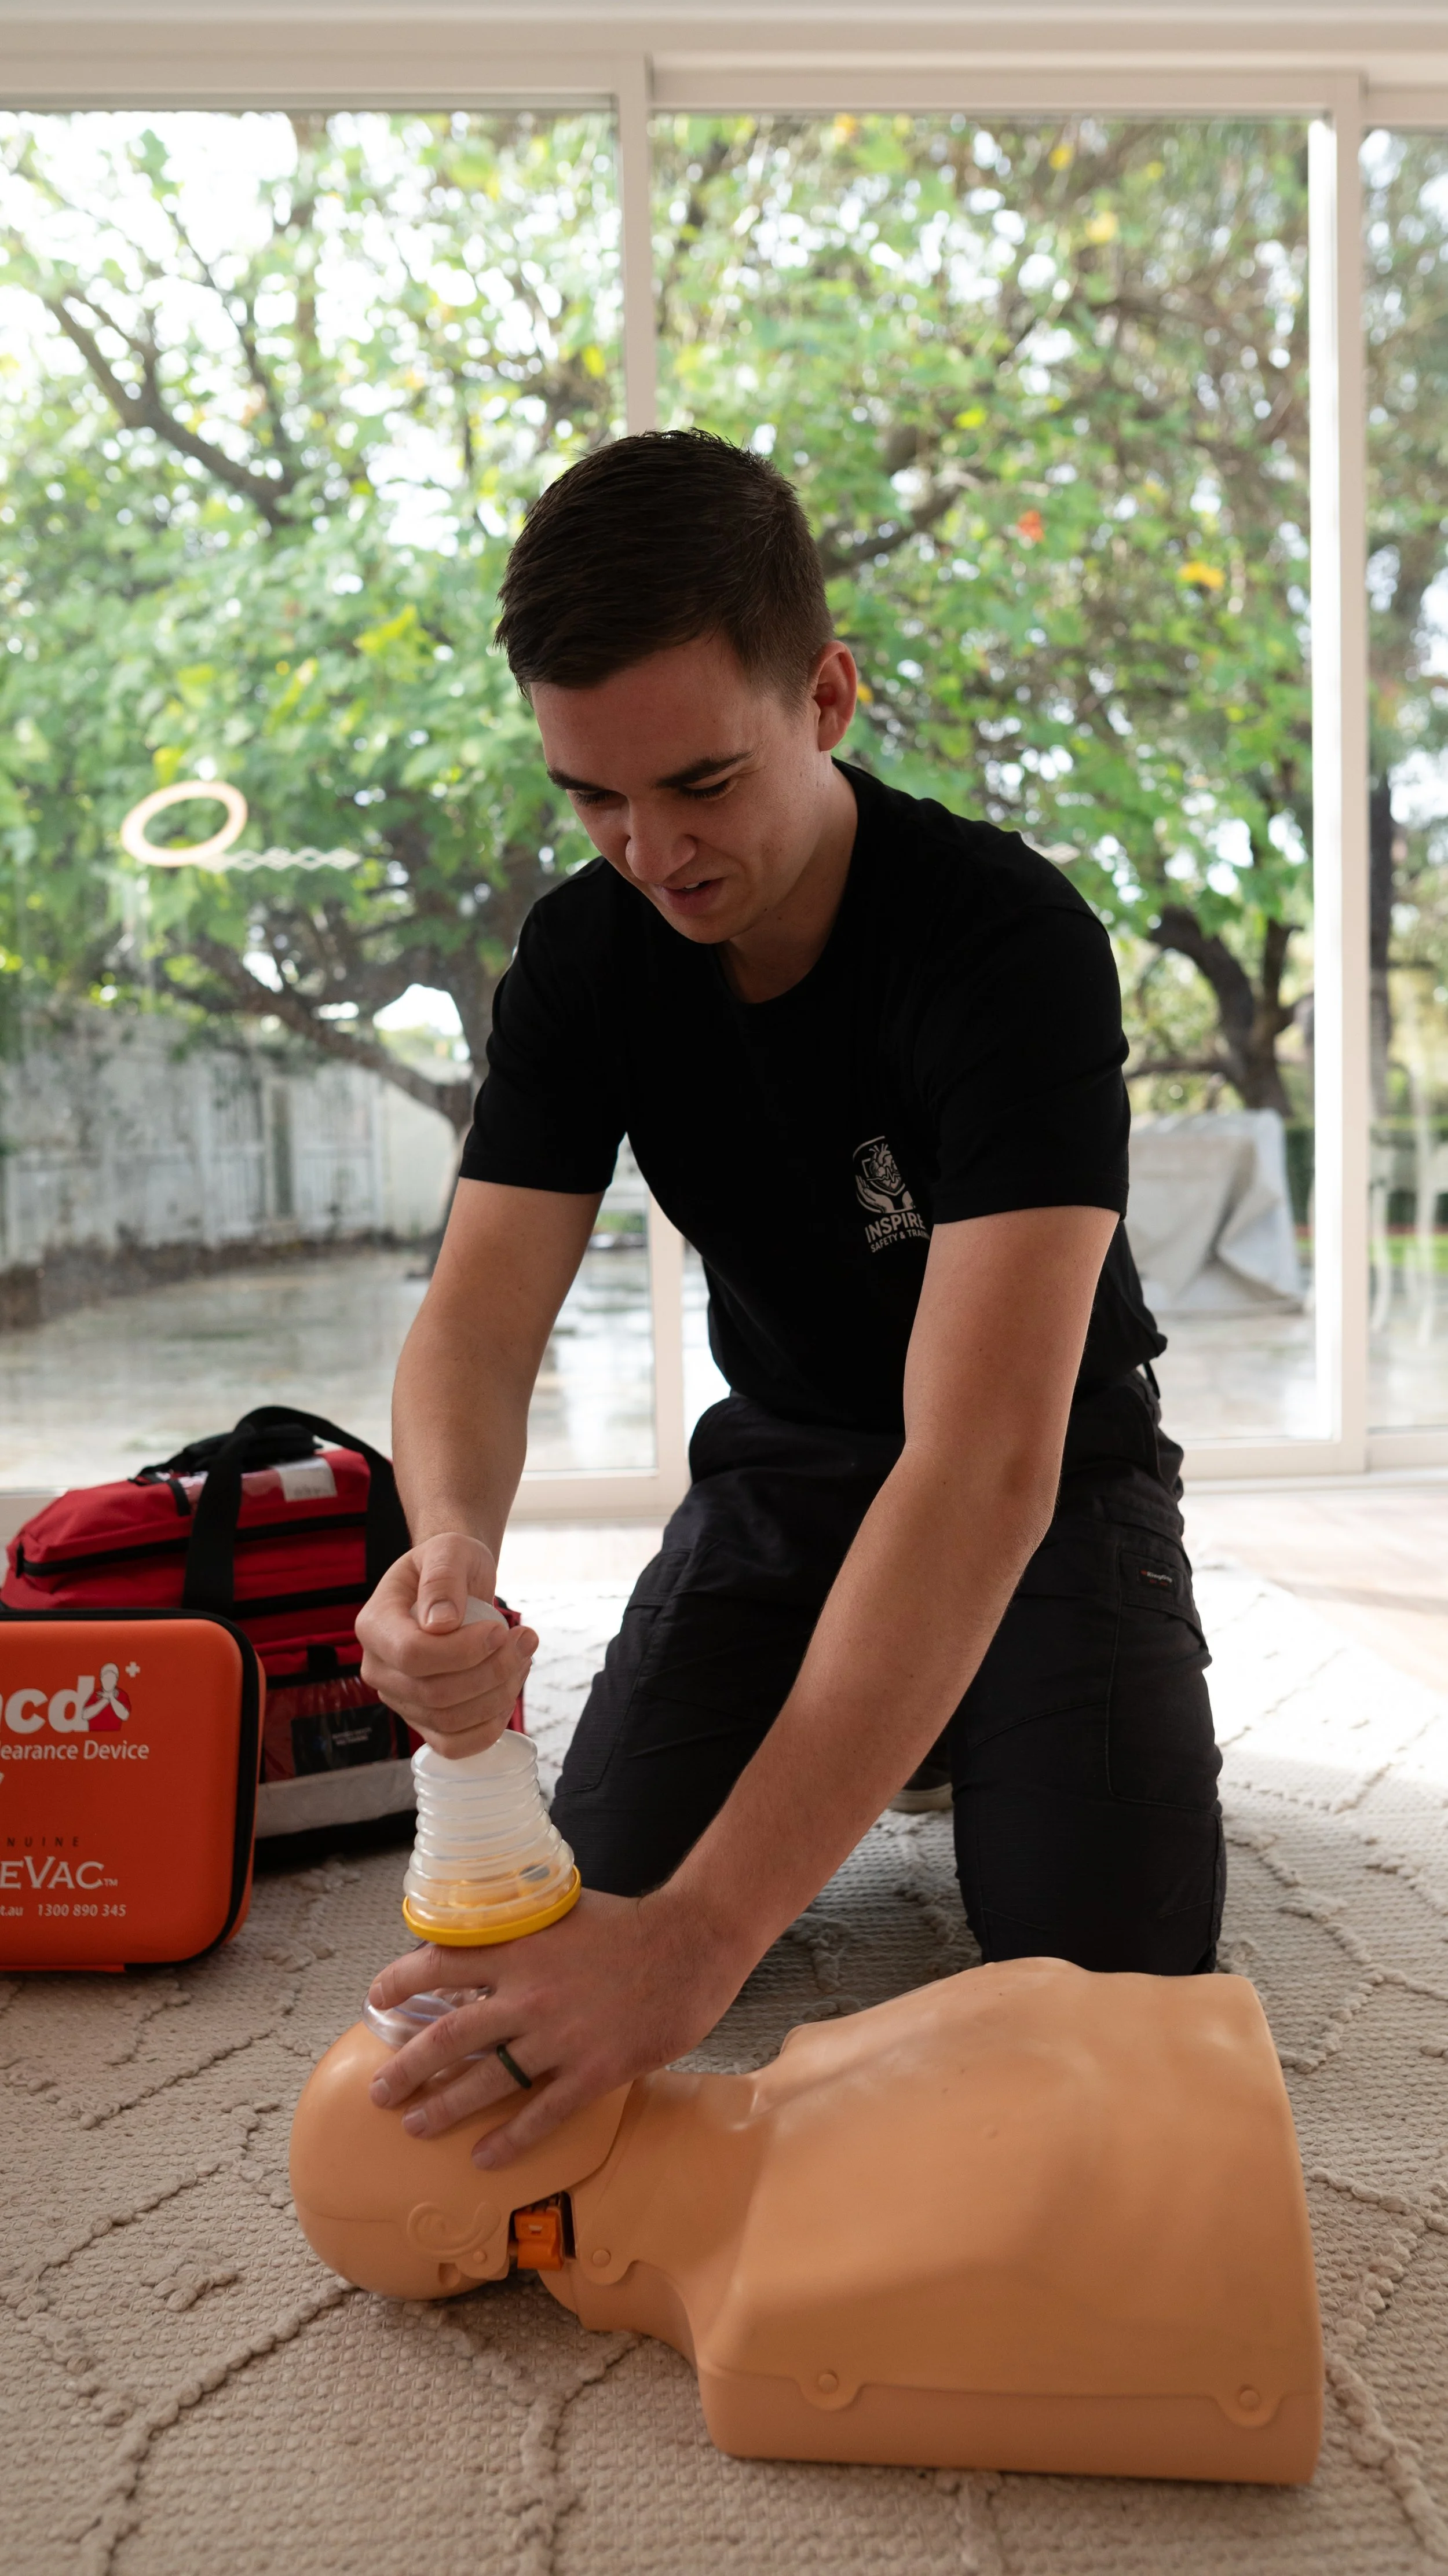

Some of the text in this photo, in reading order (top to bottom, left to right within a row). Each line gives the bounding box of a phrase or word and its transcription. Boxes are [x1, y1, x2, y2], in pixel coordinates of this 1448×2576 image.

[865, 1212, 926, 1243] INSPIRE
[871, 1234, 897, 1253] SAFETY
[899, 1231, 906, 1239] &
[0, 1675, 95, 1734] cd
[0, 1740, 149, 1760] earance Device
[38, 1904, 69, 1917] 1300
[73, 1904, 98, 1917] 890
[101, 1904, 126, 1917] 345
